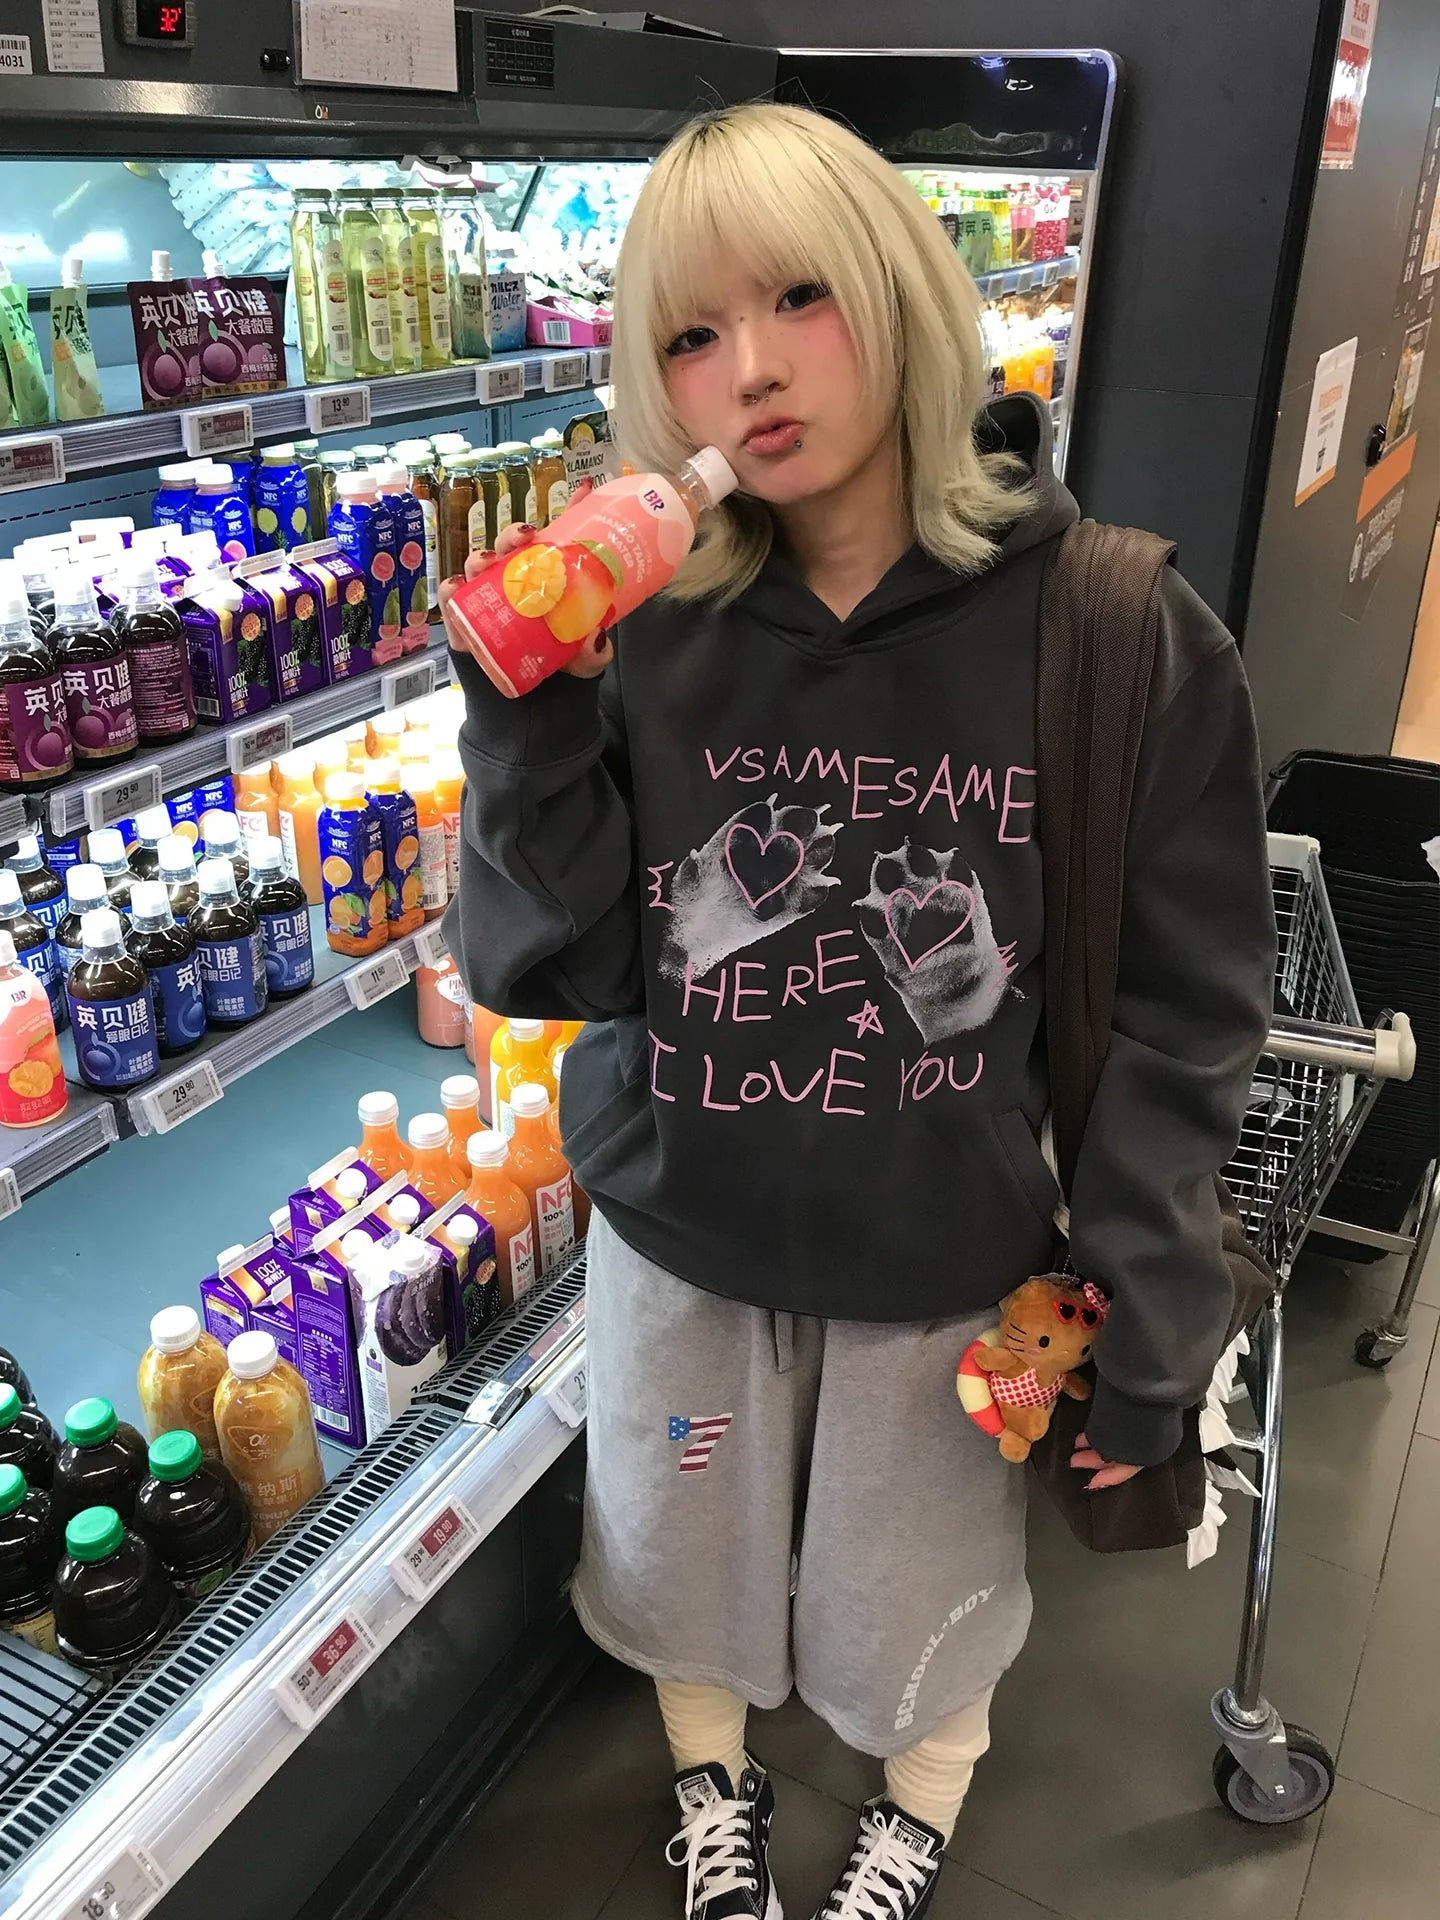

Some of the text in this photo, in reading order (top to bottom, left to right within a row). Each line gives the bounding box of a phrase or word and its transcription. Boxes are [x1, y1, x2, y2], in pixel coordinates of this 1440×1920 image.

[0, 54, 25, 68] 4031
[491, 281, 519, 293] カルピス
[138, 291, 198, 330] 英贝健
[491, 294, 521, 311] Water
[224, 317, 274, 336] 大餐救星
[263, 492, 278, 501] NFC
[643, 489, 665, 511] BR
[228, 521, 242, 531] NFC
[407, 520, 422, 531] NFC
[338, 533, 354, 543] NFC
[378, 531, 392, 542] NFC
[594, 512, 647, 585] MANGO TANGO
[607, 530, 634, 569] WATER
[331, 632, 350, 655] 100%
[279, 650, 300, 672] 100%
[63, 659, 130, 697] 英贝健
[228, 672, 248, 693] 100%
[205, 791, 223, 801] NFC
[176, 802, 193, 814] NFC
[402, 816, 415, 828] NFC
[331, 838, 348, 850] NFC
[369, 831, 382, 843] NFC
[276, 931, 310, 953] 爱眼日记
[682, 929, 866, 1023] HERE
[76, 997, 149, 1031] 英贝健
[106, 1020, 150, 1044] 爱眼日记
[648, 1029, 984, 1117] I LOVE YOU
[253, 1259, 281, 1280] 100%
[949, 1584, 997, 1626] BOY
[900, 1822, 928, 1843] CONVERSE
[909, 1837, 925, 1855] STAR
